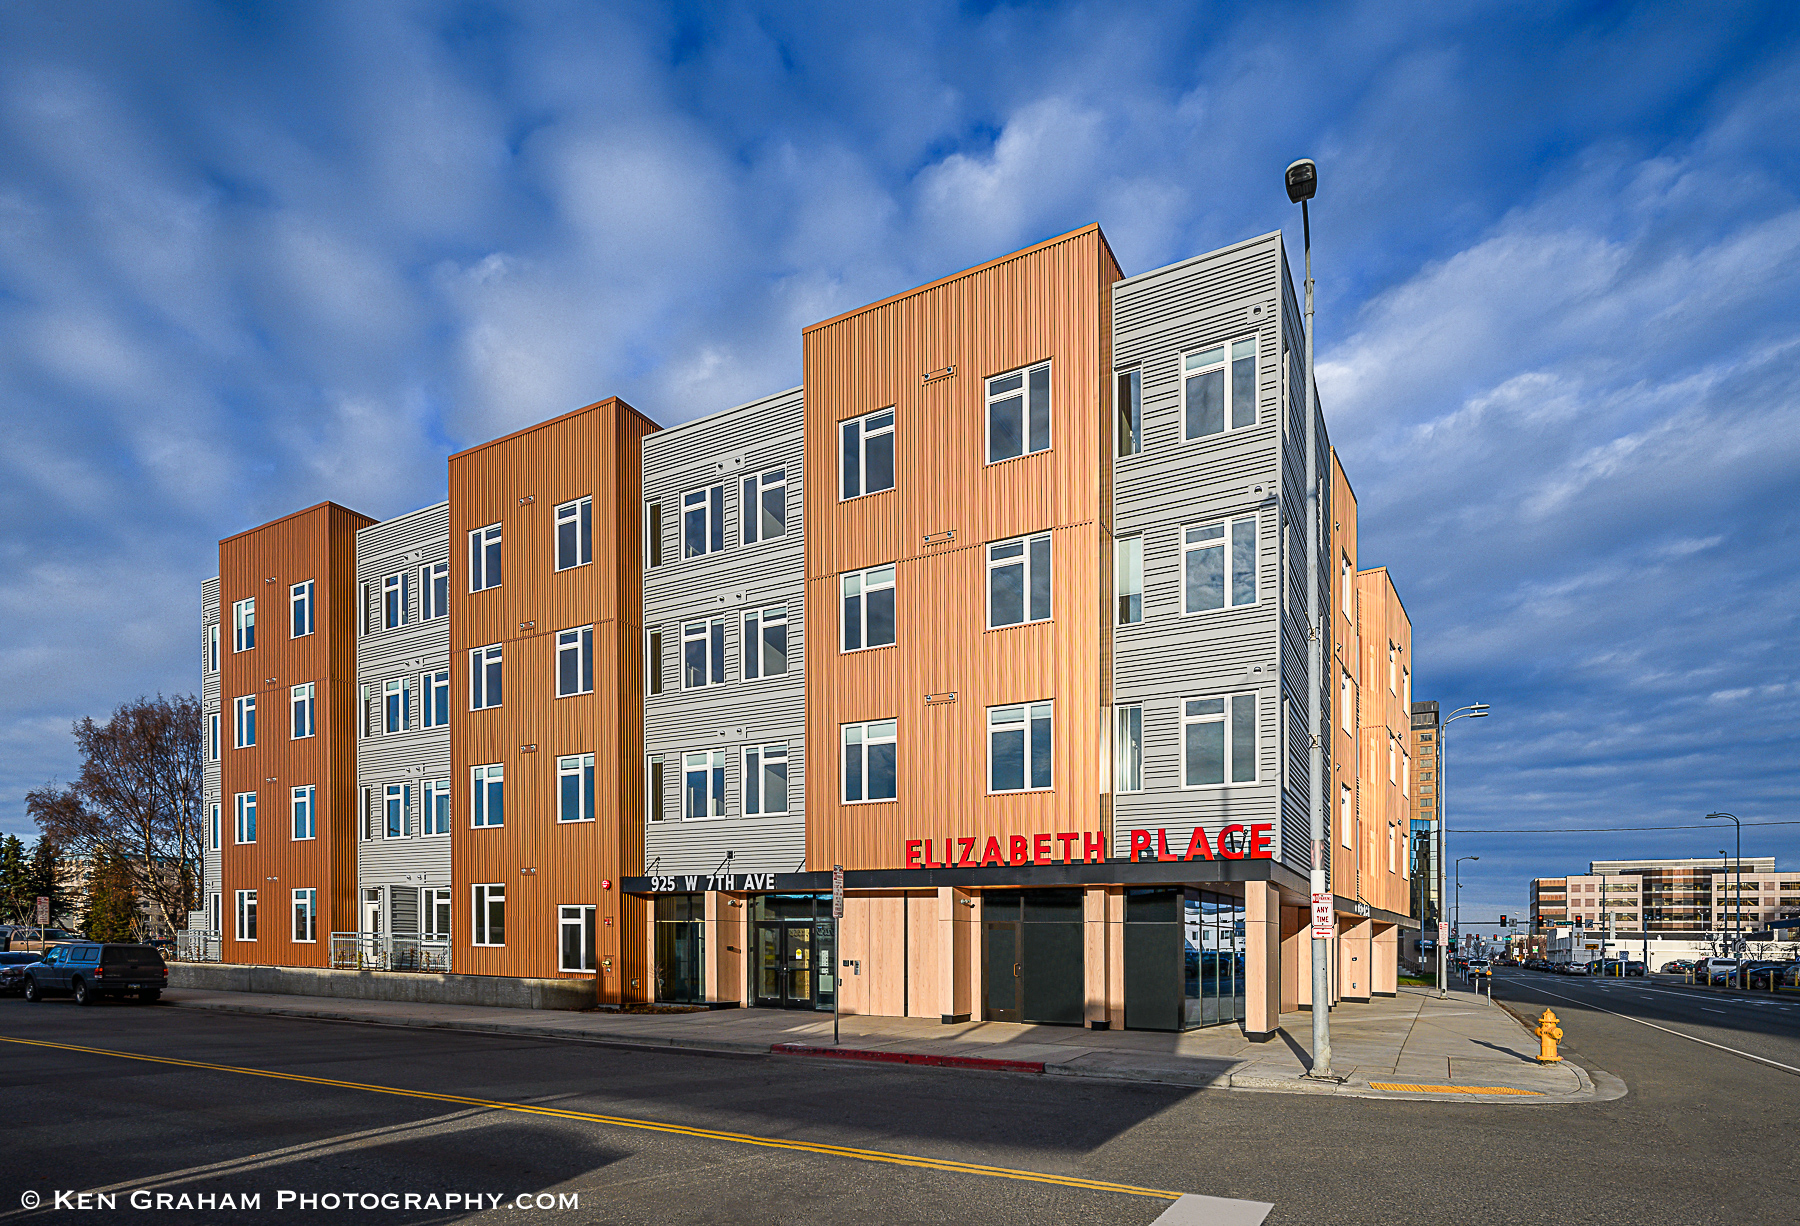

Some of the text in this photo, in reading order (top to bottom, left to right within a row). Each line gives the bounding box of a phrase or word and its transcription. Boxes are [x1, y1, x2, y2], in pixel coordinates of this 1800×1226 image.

[905, 823, 1272, 869] ELIZABETH PLACE
[651, 873, 775, 892] 925 W 7TH AVE
